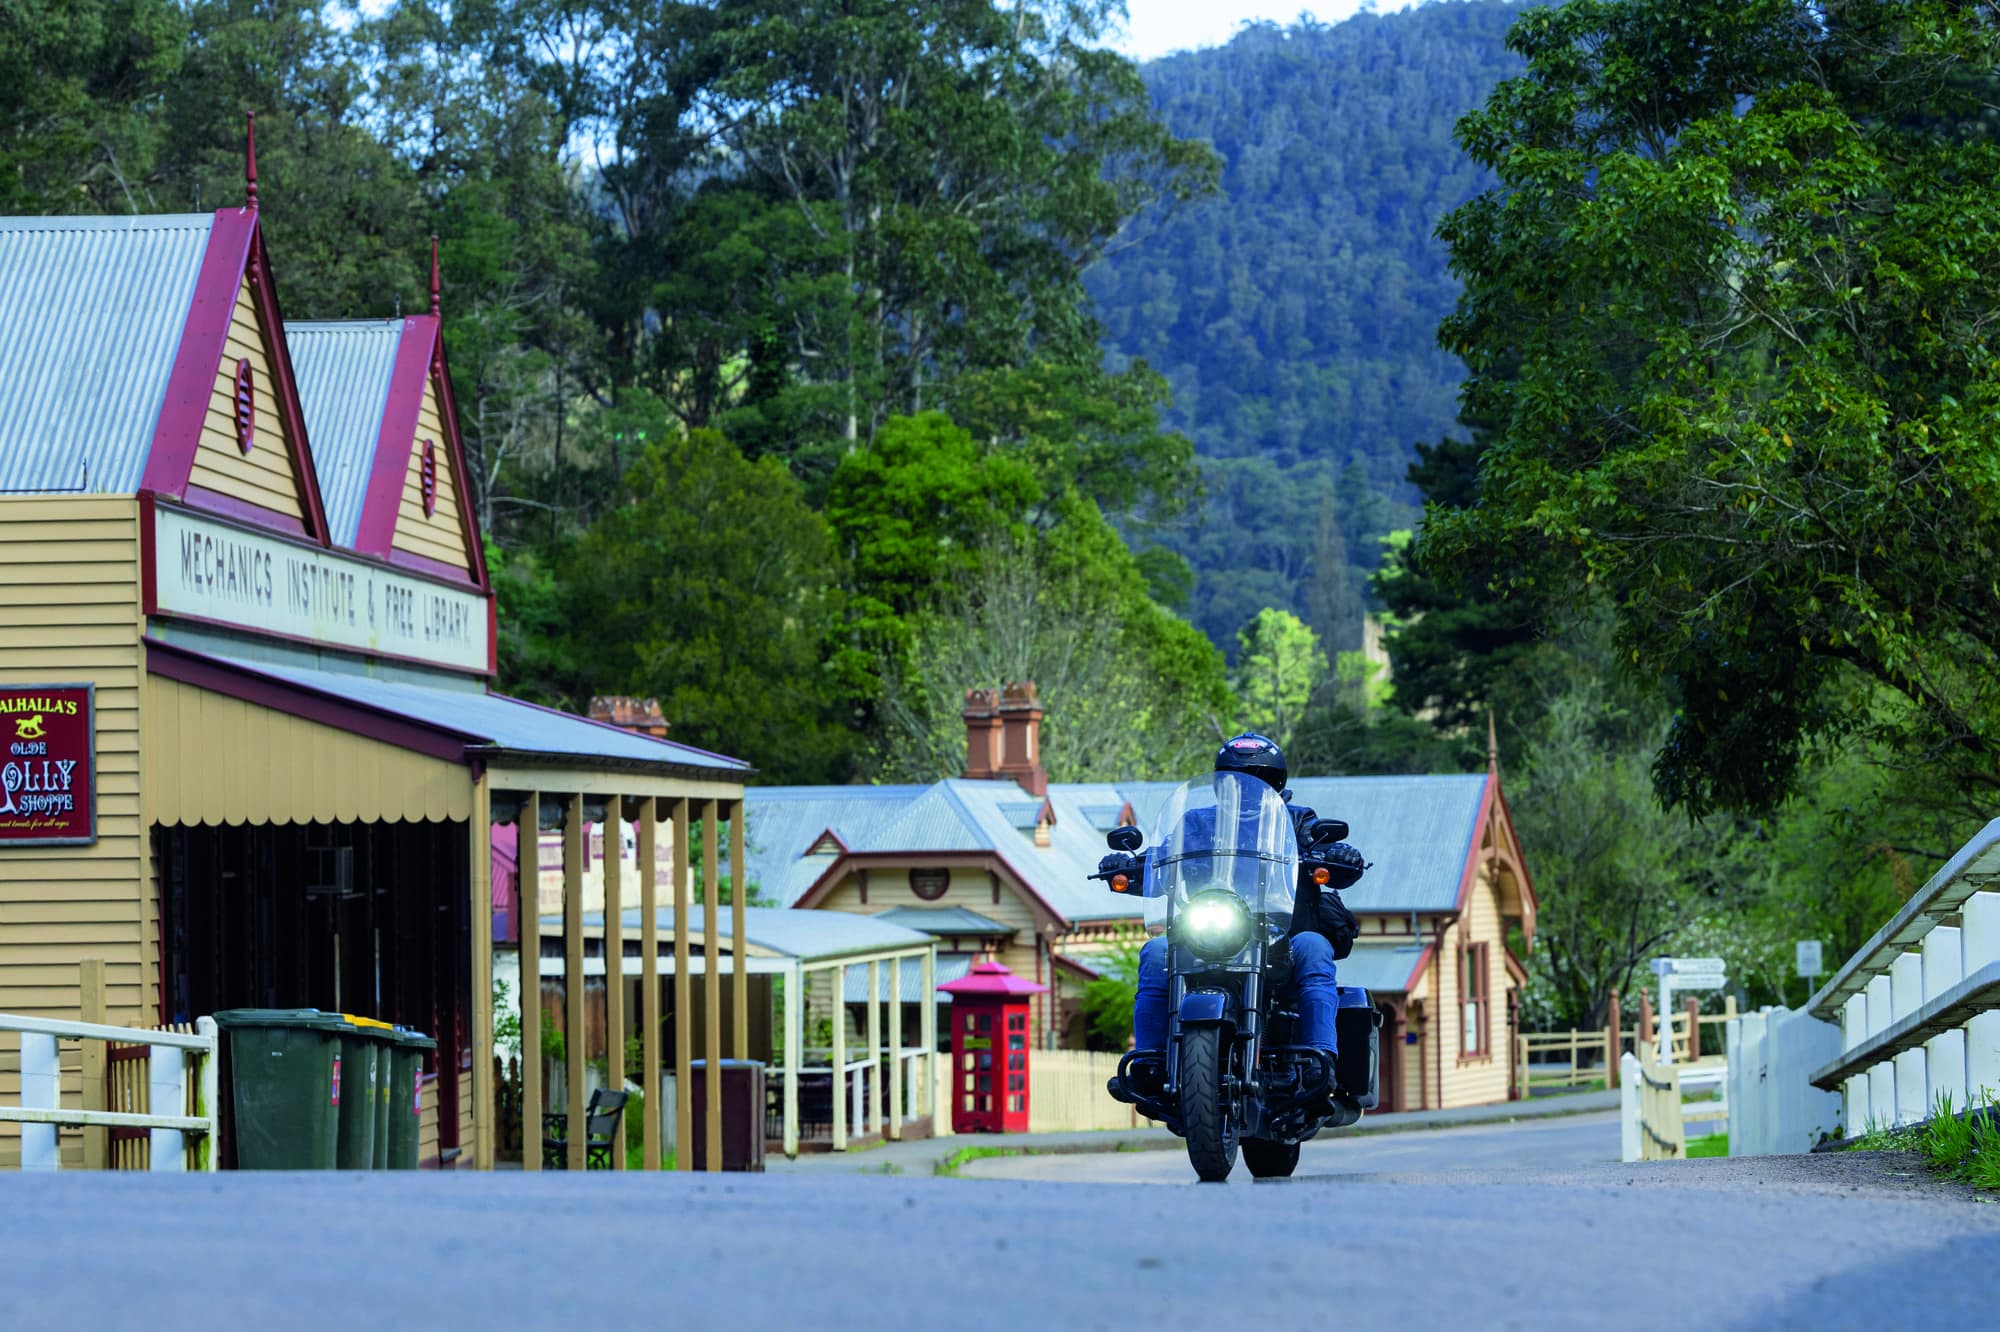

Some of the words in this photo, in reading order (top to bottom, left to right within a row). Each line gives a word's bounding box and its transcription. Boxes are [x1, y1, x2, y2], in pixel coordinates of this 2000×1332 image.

[180, 528, 273, 606] MECHANICS
[287, 557, 354, 624] INSTITUTE
[386, 583, 413, 637] FREE
[424, 592, 469, 642] LIBRARY
[0, 697, 77, 715] ALHALLA'S
[10, 742, 47, 756] OLDE
[19, 794, 73, 816] SHOPPE
